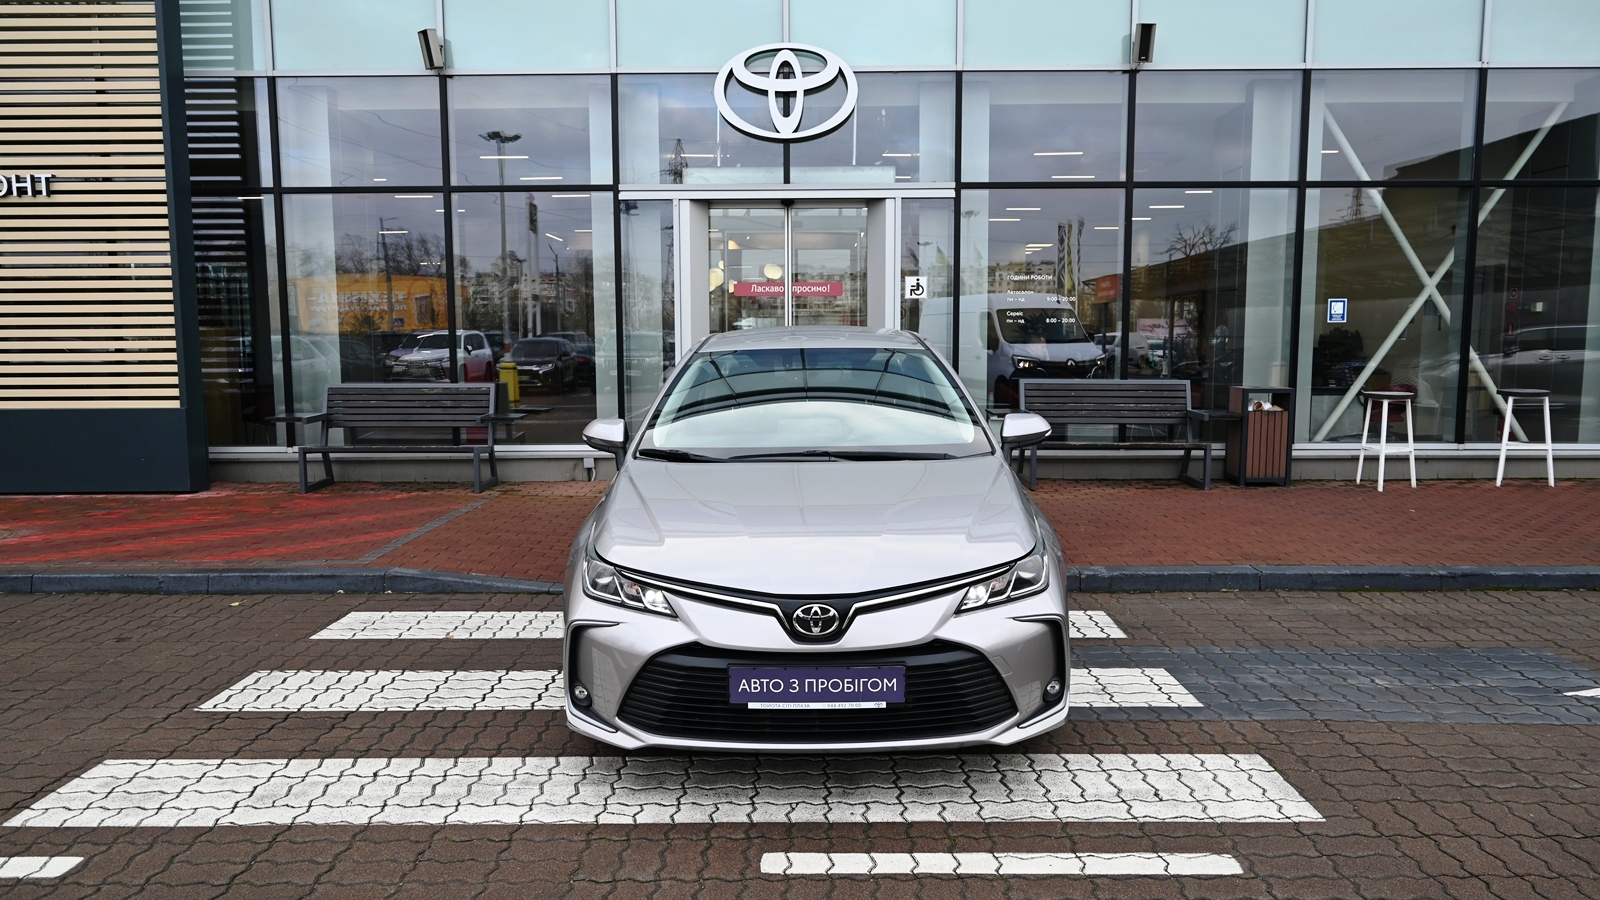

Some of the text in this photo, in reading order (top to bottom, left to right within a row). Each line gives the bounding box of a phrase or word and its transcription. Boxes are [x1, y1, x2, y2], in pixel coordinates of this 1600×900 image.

[750, 284, 830, 294] Ласкаво просимо!
[738, 677, 898, 693] АВТО З ПРОБІГОМ
